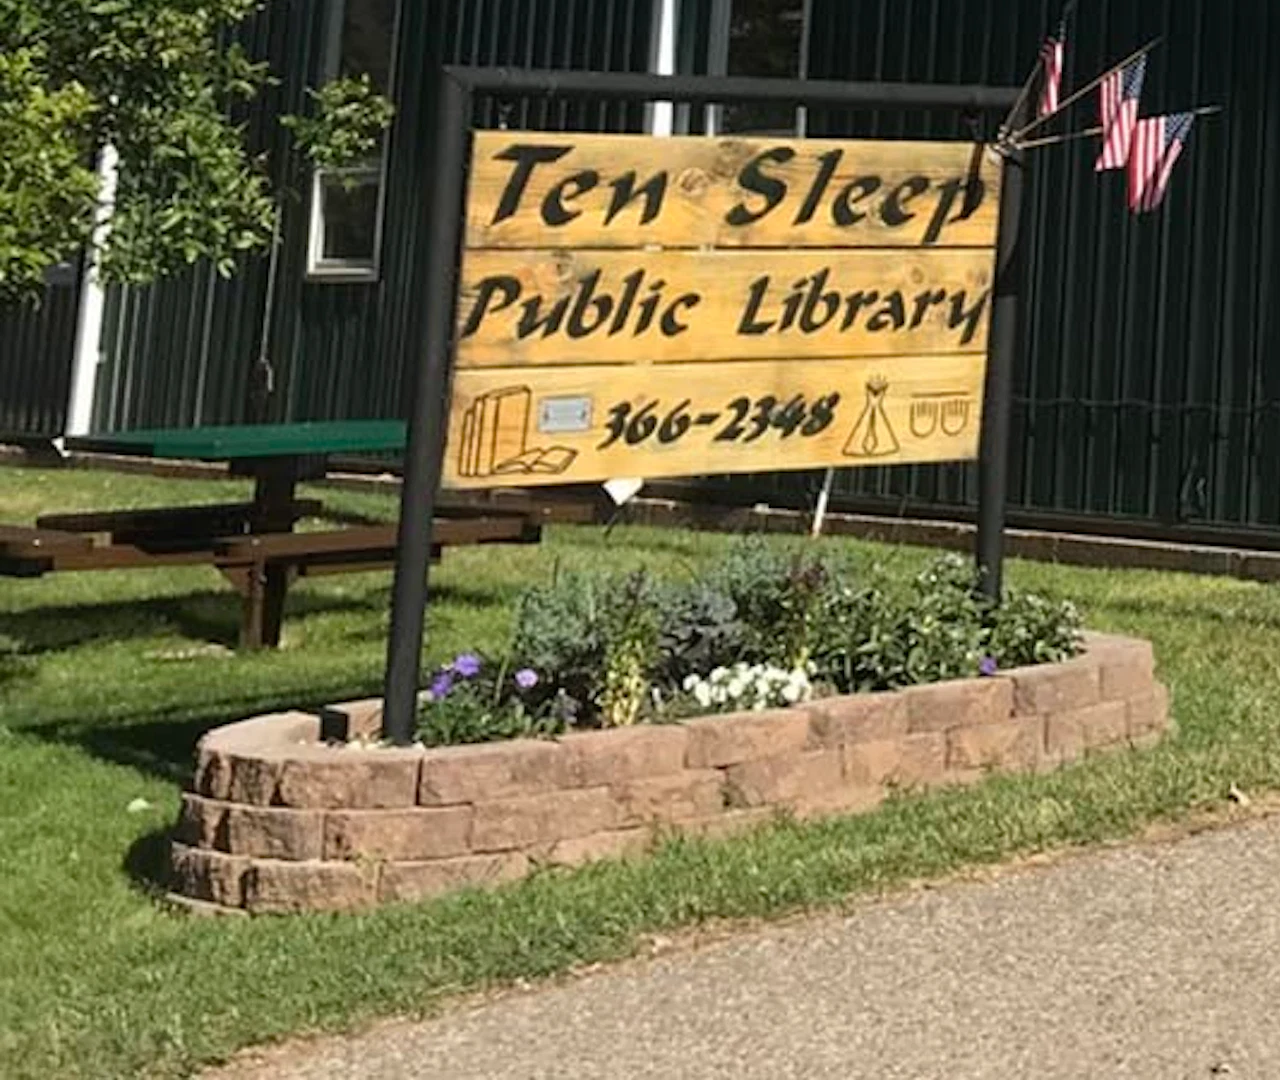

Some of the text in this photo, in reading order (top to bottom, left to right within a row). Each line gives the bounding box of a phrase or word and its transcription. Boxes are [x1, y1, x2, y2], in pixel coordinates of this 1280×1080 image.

[491, 143, 986, 244] Ten Sleep
[461, 267, 992, 345] Public Library
[596, 391, 841, 451] 366-2348
